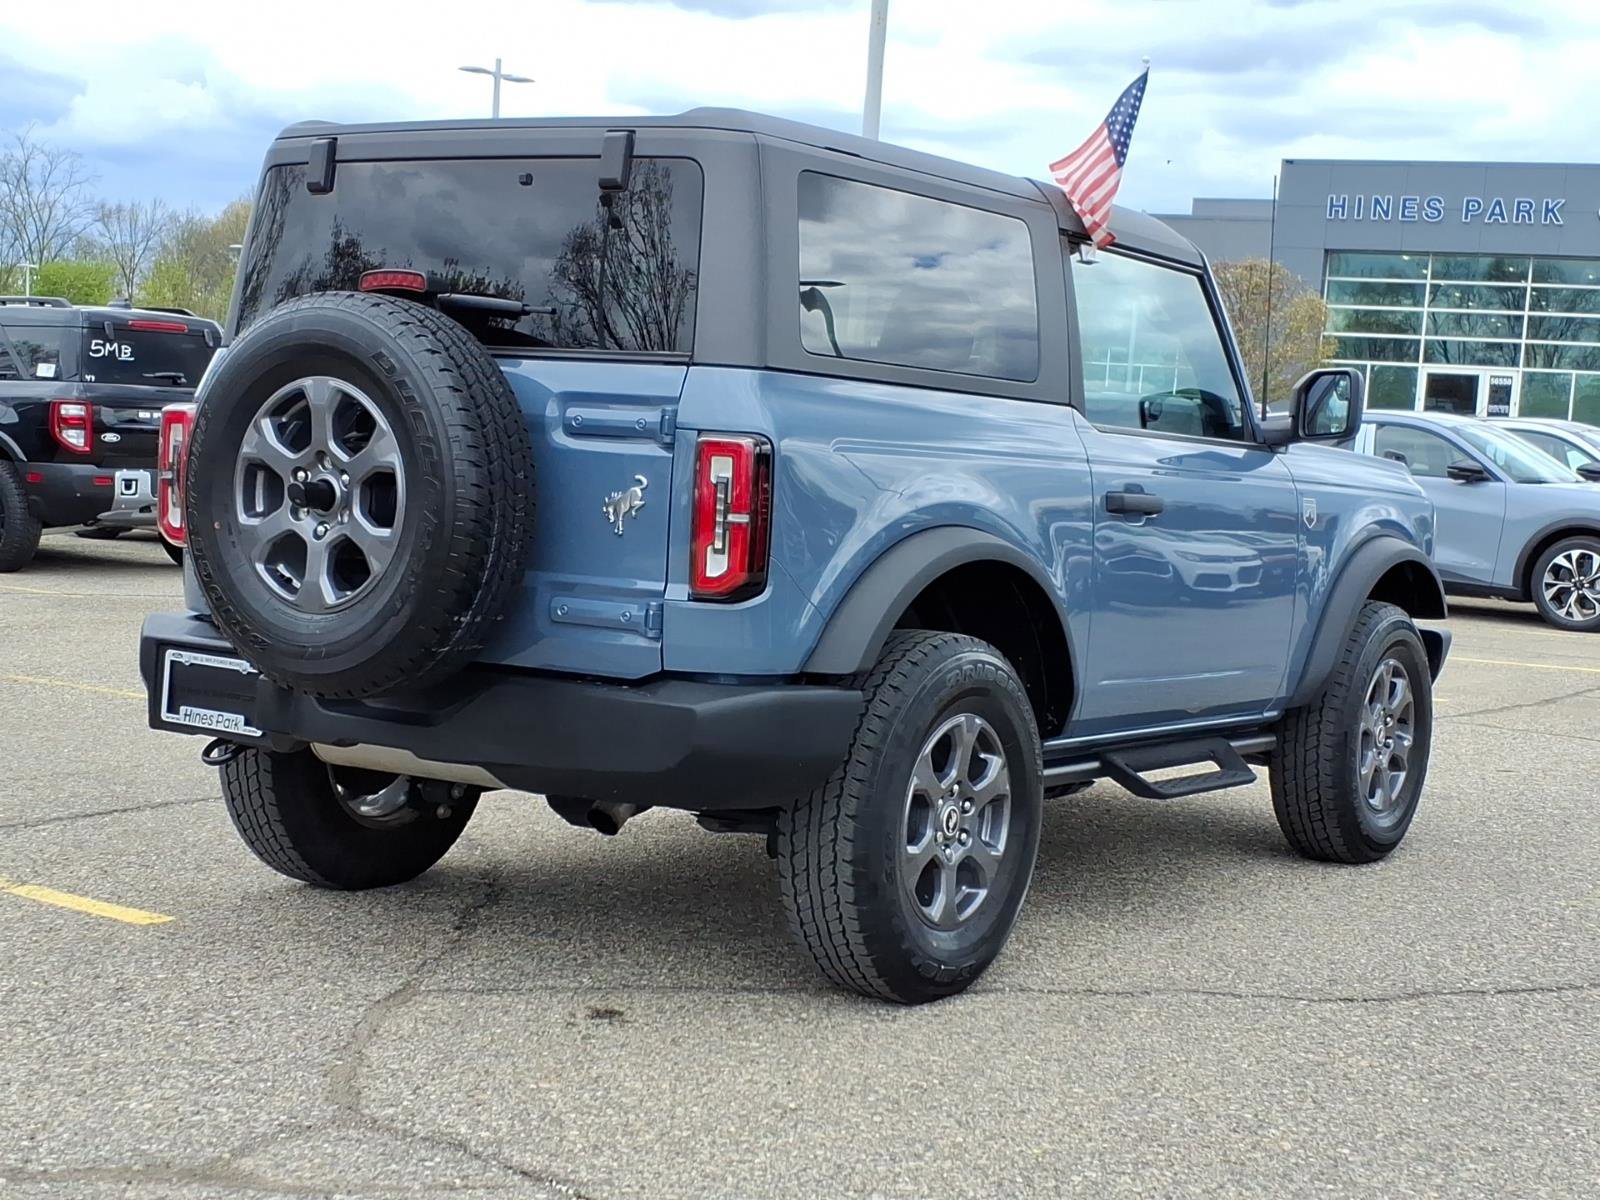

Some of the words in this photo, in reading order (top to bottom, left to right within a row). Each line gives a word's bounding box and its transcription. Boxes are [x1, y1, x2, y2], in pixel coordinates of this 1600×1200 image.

[1326, 194, 1445, 222] HINES
[1462, 197, 1566, 225] PARK
[89, 339, 135, 360] 5MB
[183, 708, 214, 727] Hines
[215, 713, 241, 731] Park
